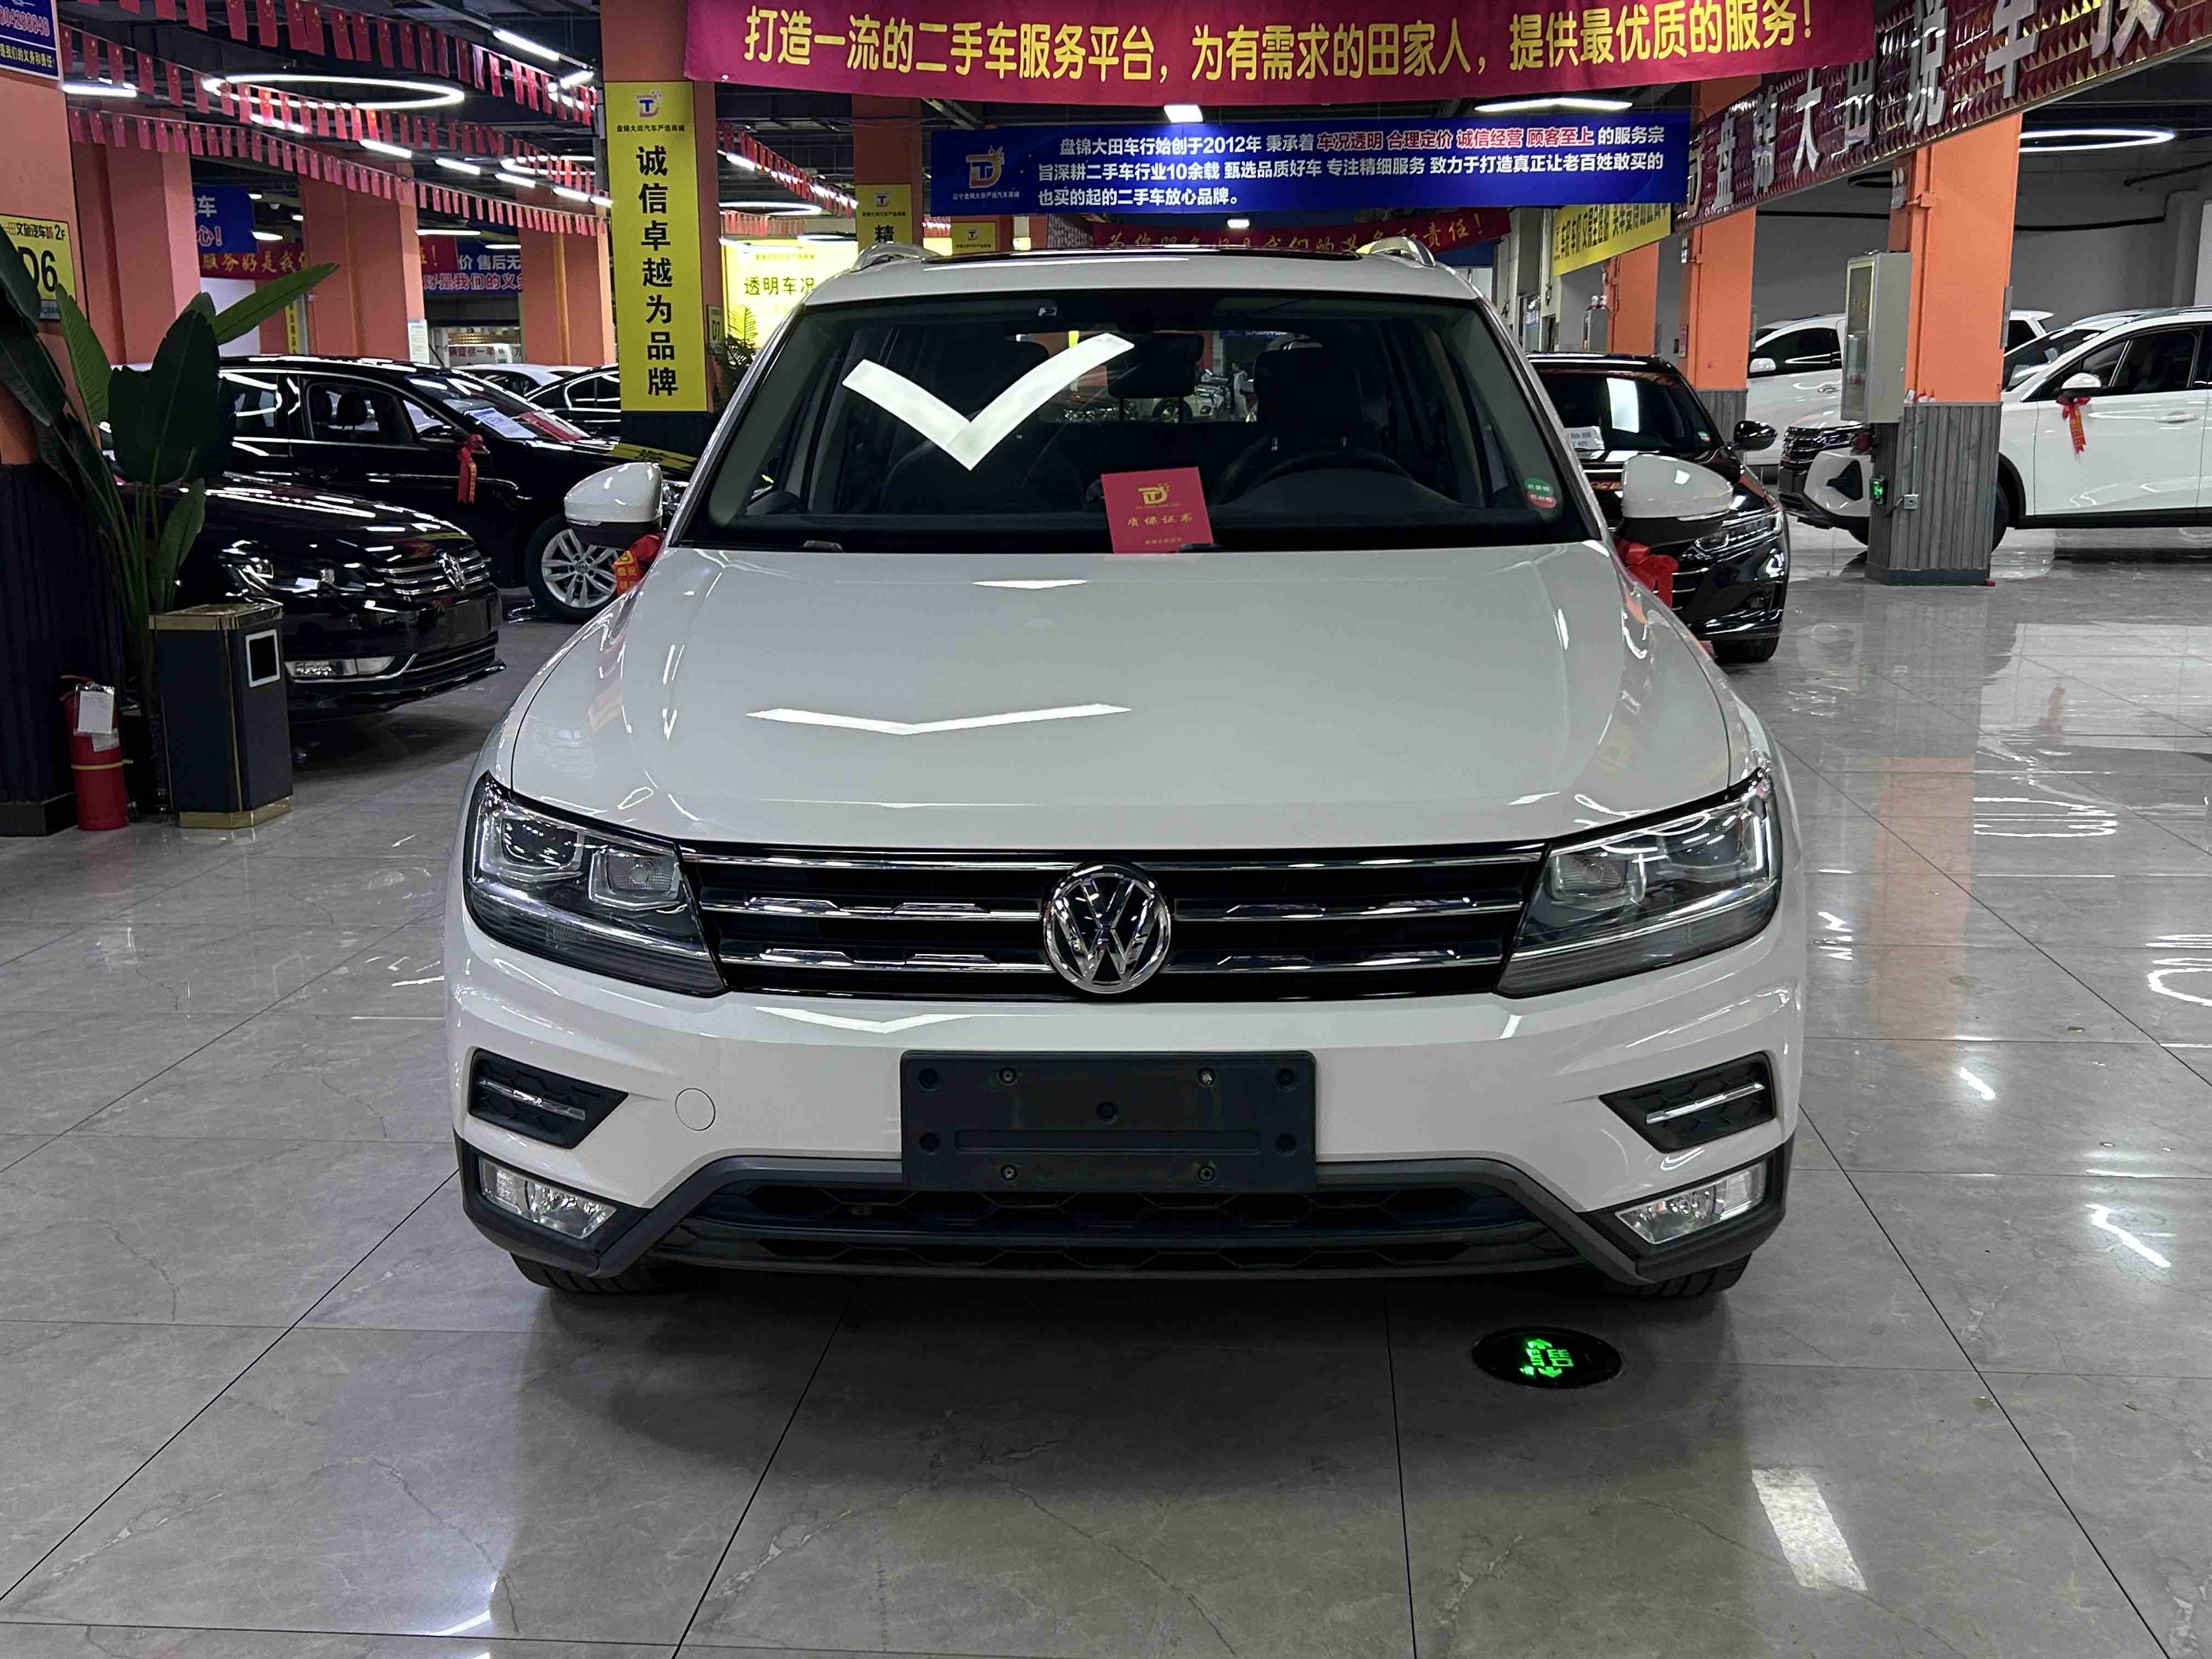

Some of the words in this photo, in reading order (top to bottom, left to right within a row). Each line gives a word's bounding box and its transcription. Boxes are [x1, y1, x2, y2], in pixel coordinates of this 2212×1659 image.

[1060, 136, 1261, 157] 盘锦大田车行始创于2012年
[1266, 134, 1314, 152] 秉承着
[1317, 131, 1382, 151] 车况透明
[1387, 130, 1452, 149] 合理定价
[1457, 128, 1523, 148] 诚信经营
[1527, 127, 1594, 146] 顾客至上
[1598, 126, 1664, 144] 的服务宗
[1039, 162, 1221, 182] 旨深耕二手车行业10余载
[1224, 159, 1322, 179] 甄选品质好车
[1327, 157, 1425, 176] 专注精细服务
[1430, 151, 1663, 174] 致力于打造真正让老百姓敢买的
[193, 195, 217, 218] 车
[1038, 188, 1238, 207] 也买的起的二手车放心品牌。
[874, 224, 894, 243] 精
[636, 145, 678, 397] 诚信卓越为品牌
[744, 276, 814, 295] 透明车况
